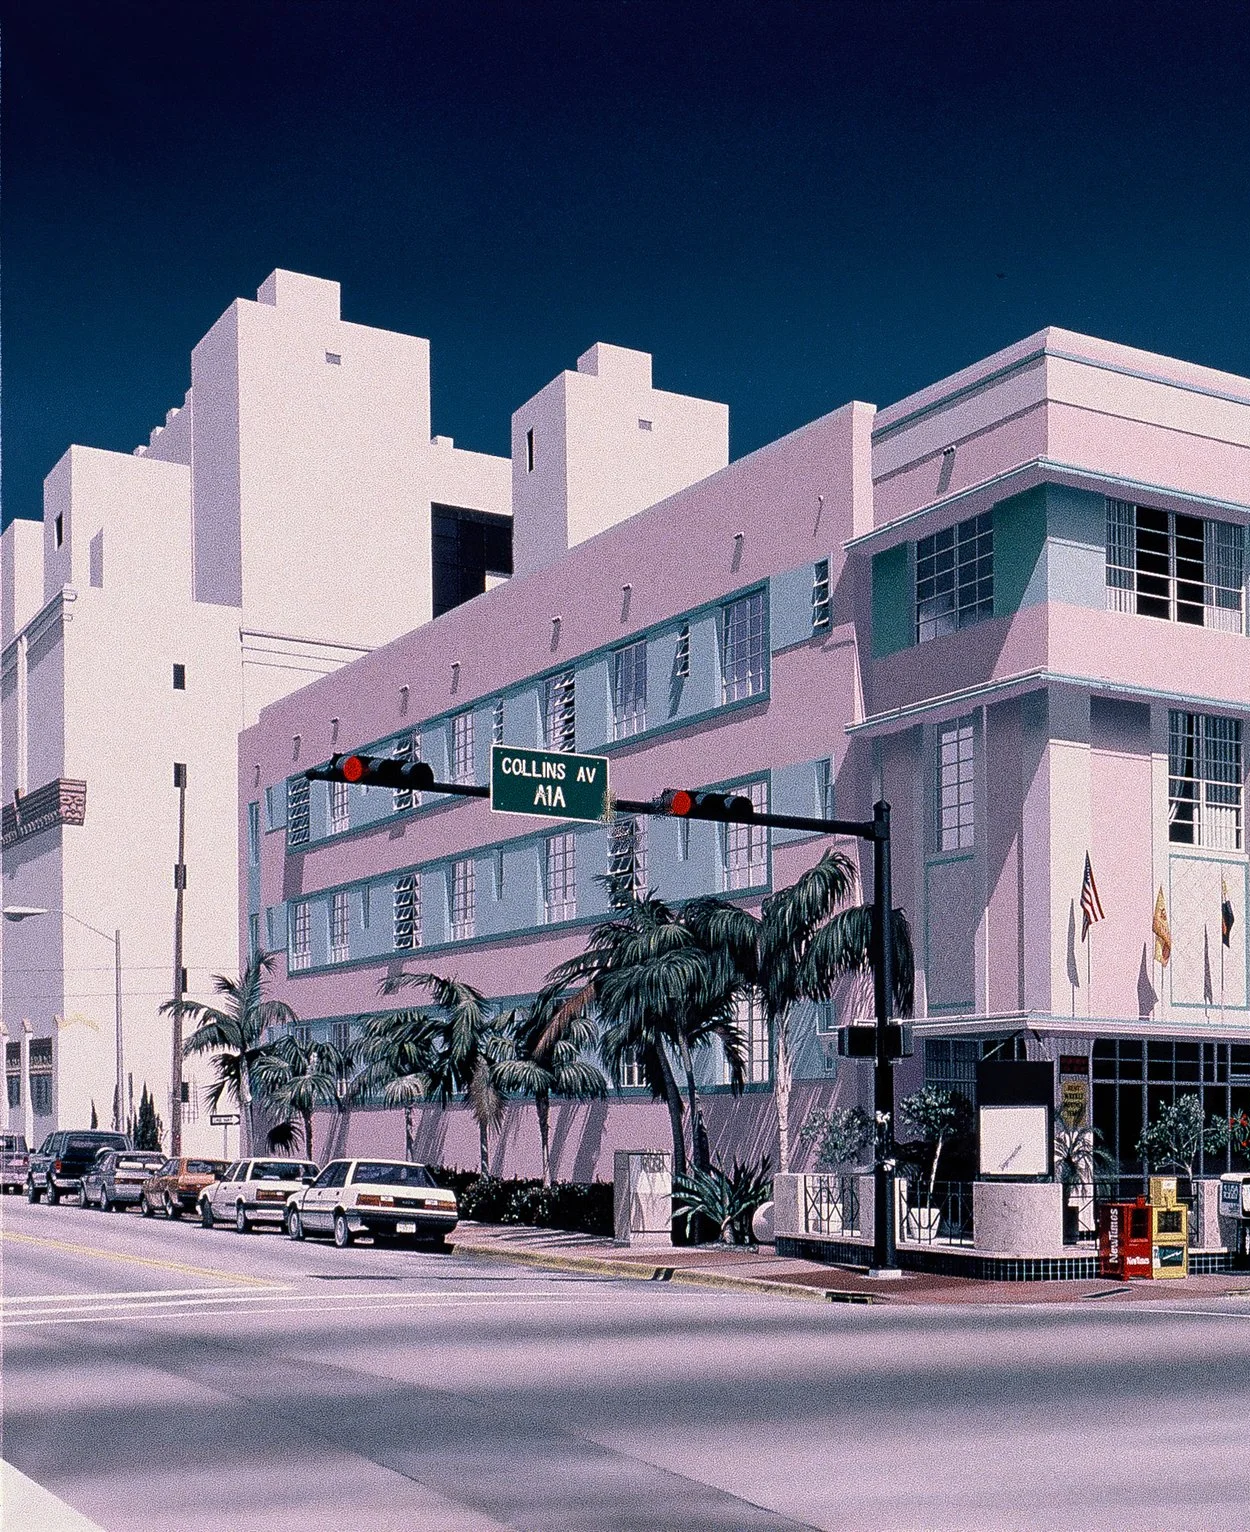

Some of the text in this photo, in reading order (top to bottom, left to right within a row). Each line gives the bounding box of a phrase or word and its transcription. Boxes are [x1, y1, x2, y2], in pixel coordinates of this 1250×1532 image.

[501, 757, 596, 784] COLLINS AV
[533, 783, 566, 808] A1A
